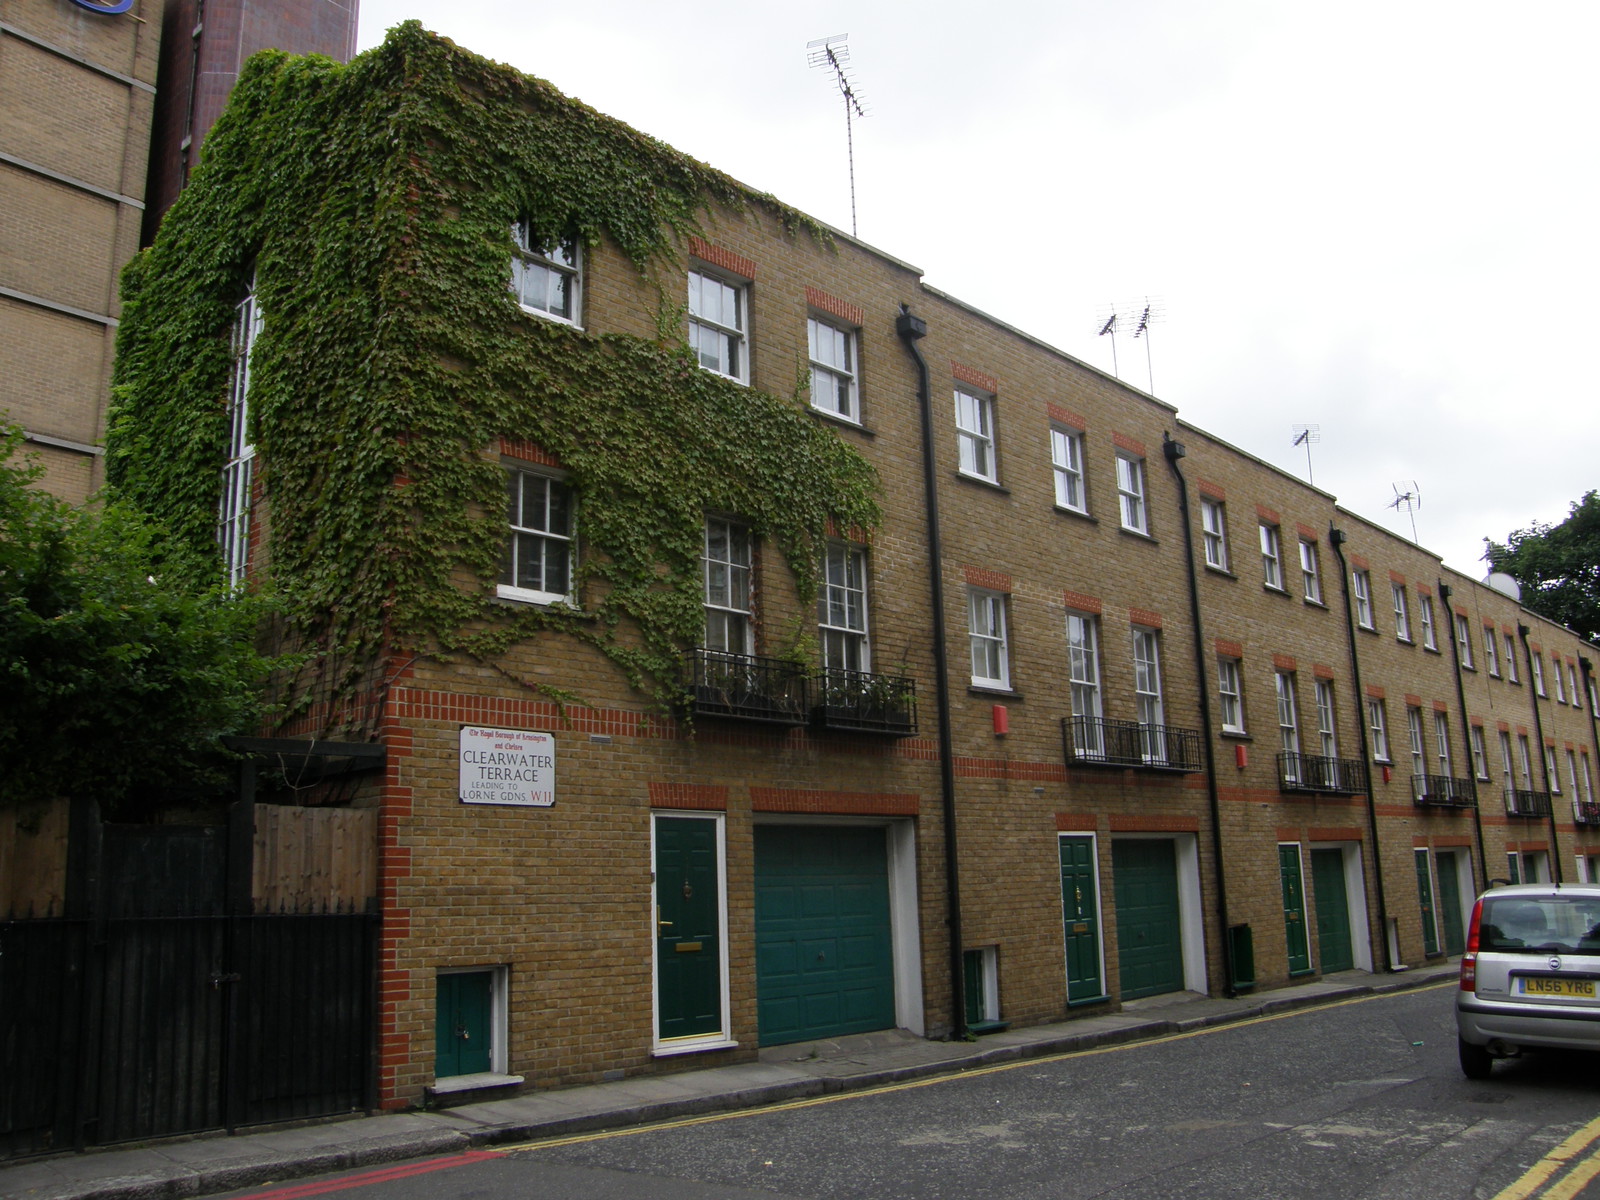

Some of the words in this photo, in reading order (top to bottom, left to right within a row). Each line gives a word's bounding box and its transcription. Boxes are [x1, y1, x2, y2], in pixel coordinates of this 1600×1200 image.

[469, 729, 479, 737] The
[480, 729, 494, 739] Royal
[495, 731, 515, 741] Borough
[516, 732, 521, 740] of
[522, 733, 547, 743] Kensington
[463, 750, 553, 768] CLEARWATER
[478, 766, 538, 782] TERRACE
[471, 781, 504, 790] LEADING
[463, 790, 496, 800] LORNE
[1526, 980, 1562, 993] LN56
[1566, 981, 1593, 994] YRG
